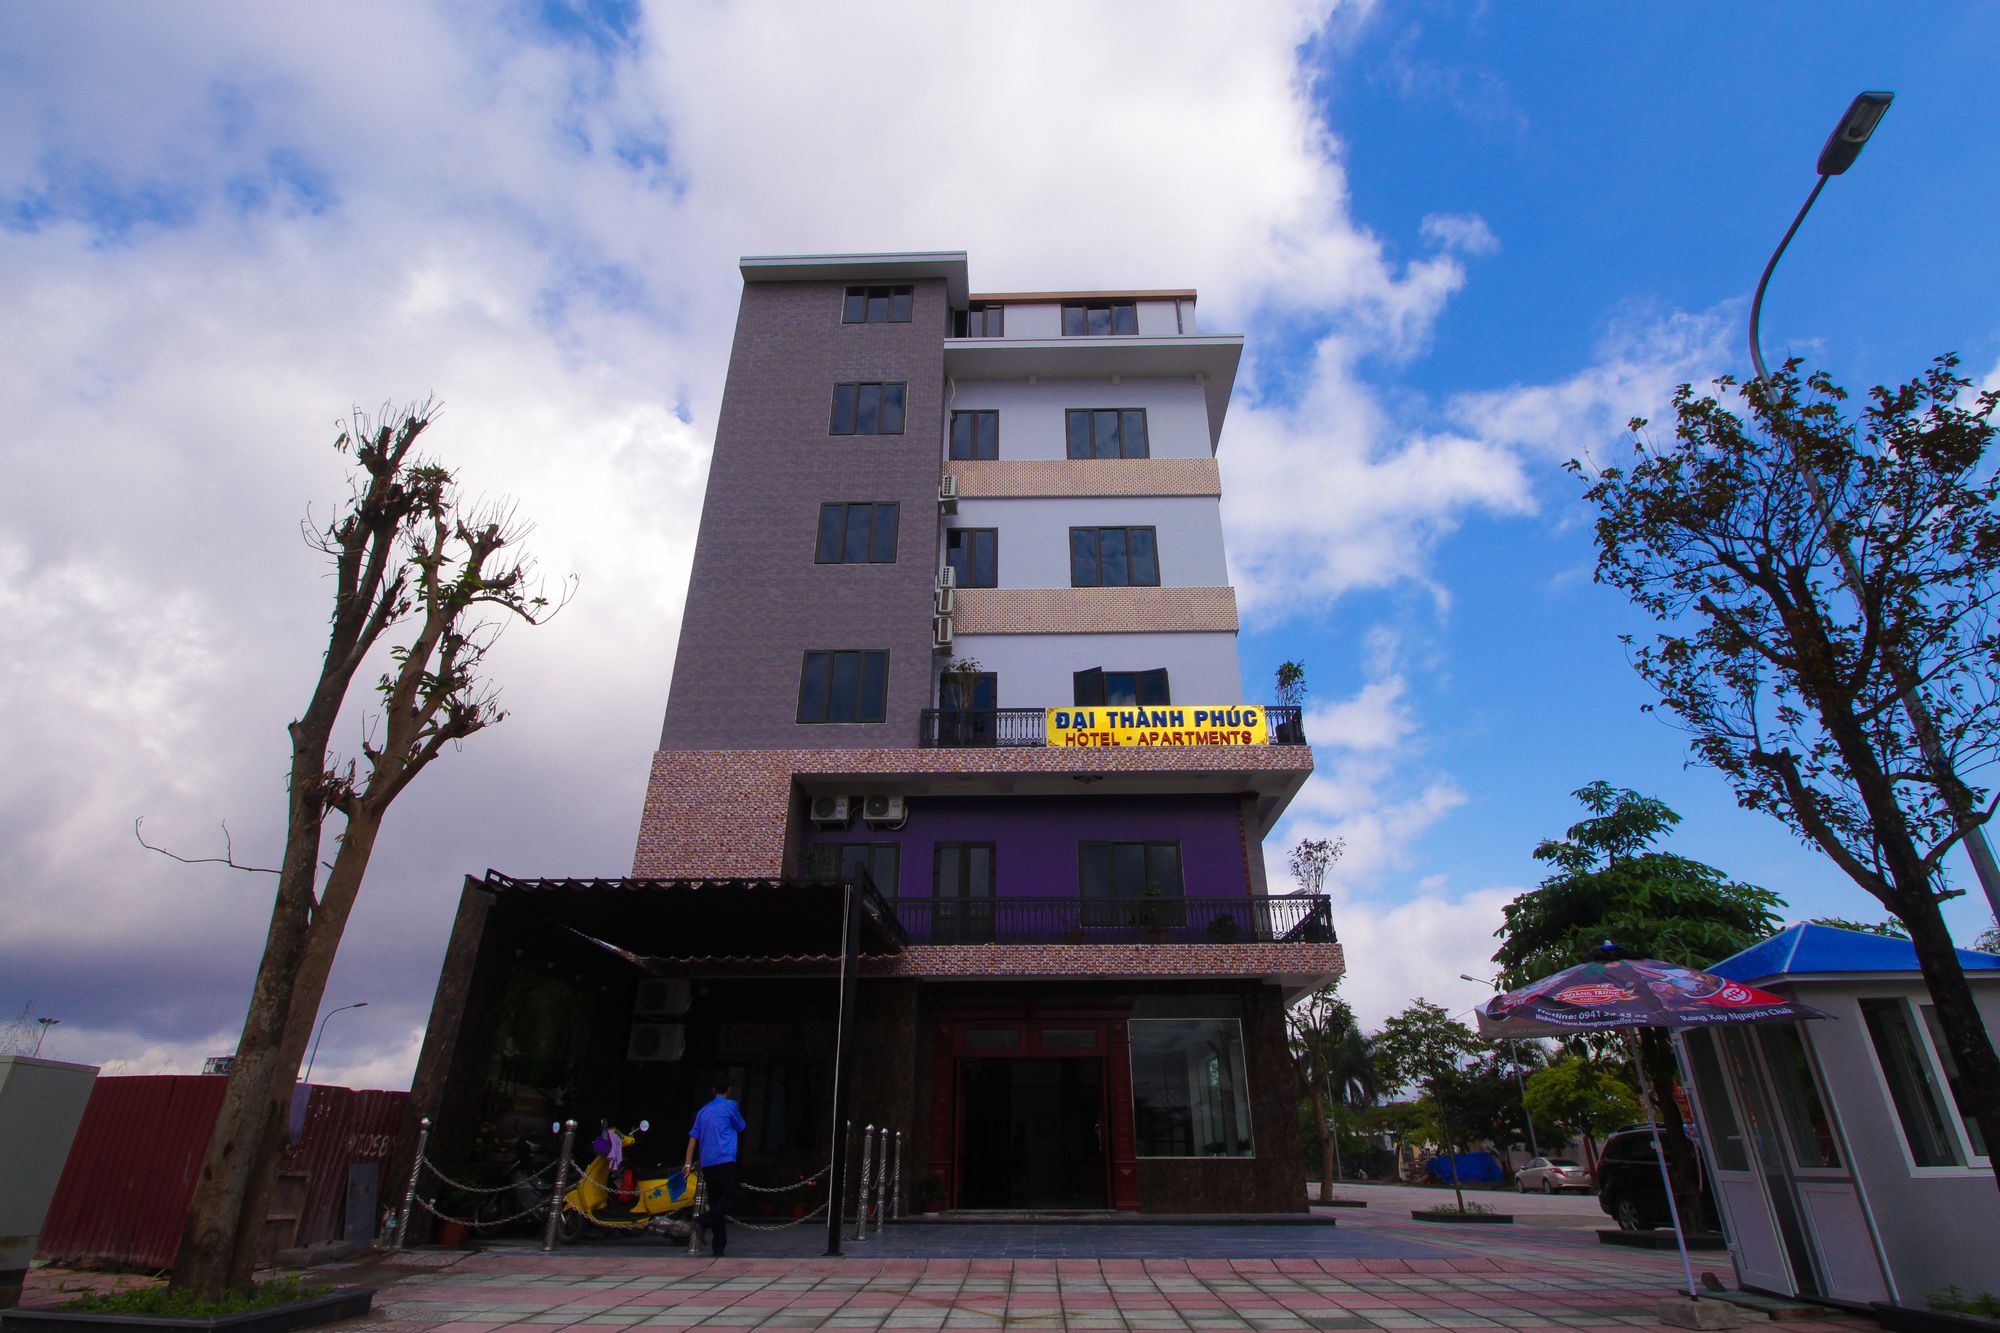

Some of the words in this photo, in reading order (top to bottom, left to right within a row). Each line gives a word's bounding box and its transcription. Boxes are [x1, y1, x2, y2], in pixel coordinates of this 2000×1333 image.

[1055, 710, 1095, 732] ĐẠI
[1106, 706, 1185, 729] THÀNH
[1194, 705, 1258, 728] PHÚC
[1065, 731, 1120, 747] HOTEL
[1138, 730, 1252, 746] APARTMENTS
[1578, 1010, 1601, 1020] 0941
[1679, 1014, 1708, 1022] Rang
[1707, 1013, 1728, 1022] Xay
[1727, 1010, 1769, 1021] Nguyên
